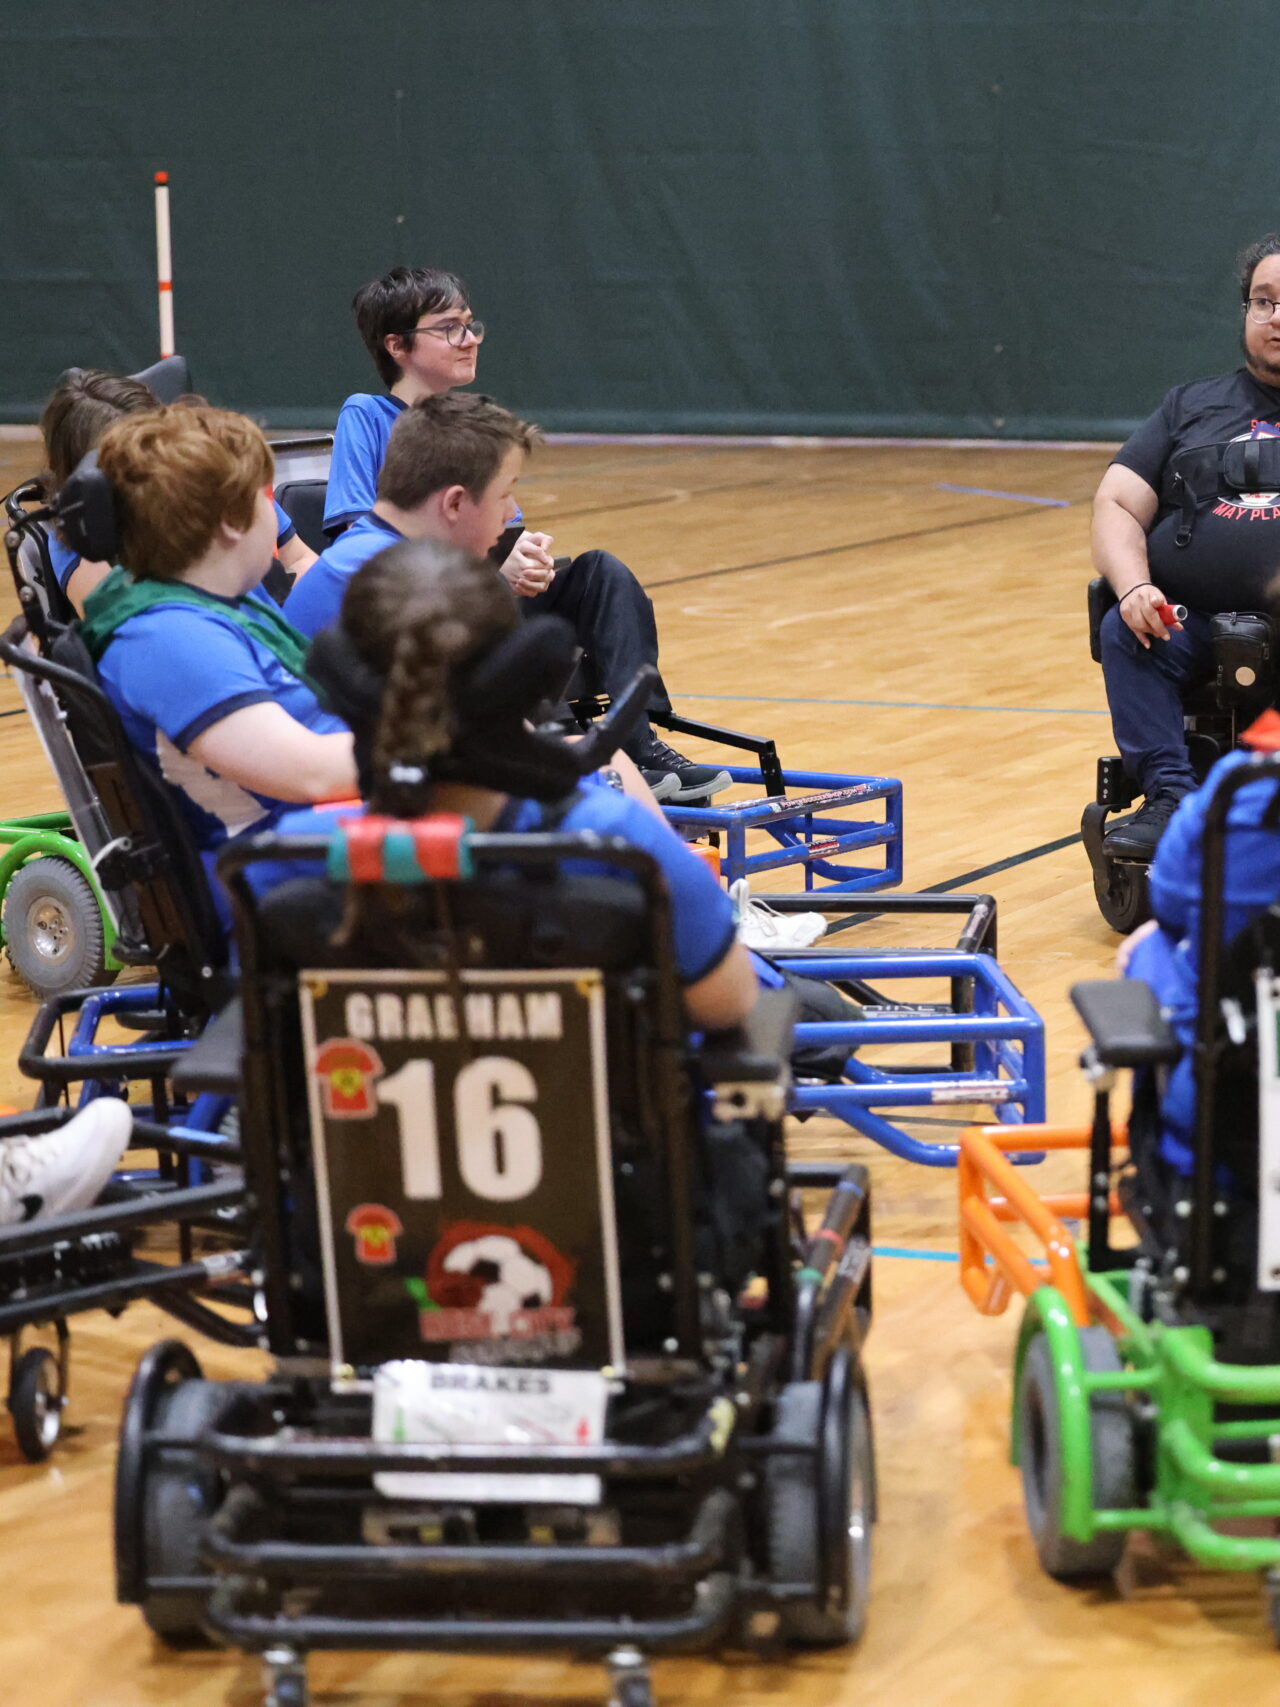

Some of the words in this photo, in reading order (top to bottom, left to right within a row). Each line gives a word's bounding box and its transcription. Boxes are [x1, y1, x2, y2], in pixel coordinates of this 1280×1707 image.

[1212, 503, 1247, 520] MAY
[375, 1055, 543, 1202] 16
[431, 1373, 552, 1395] BRAKES
